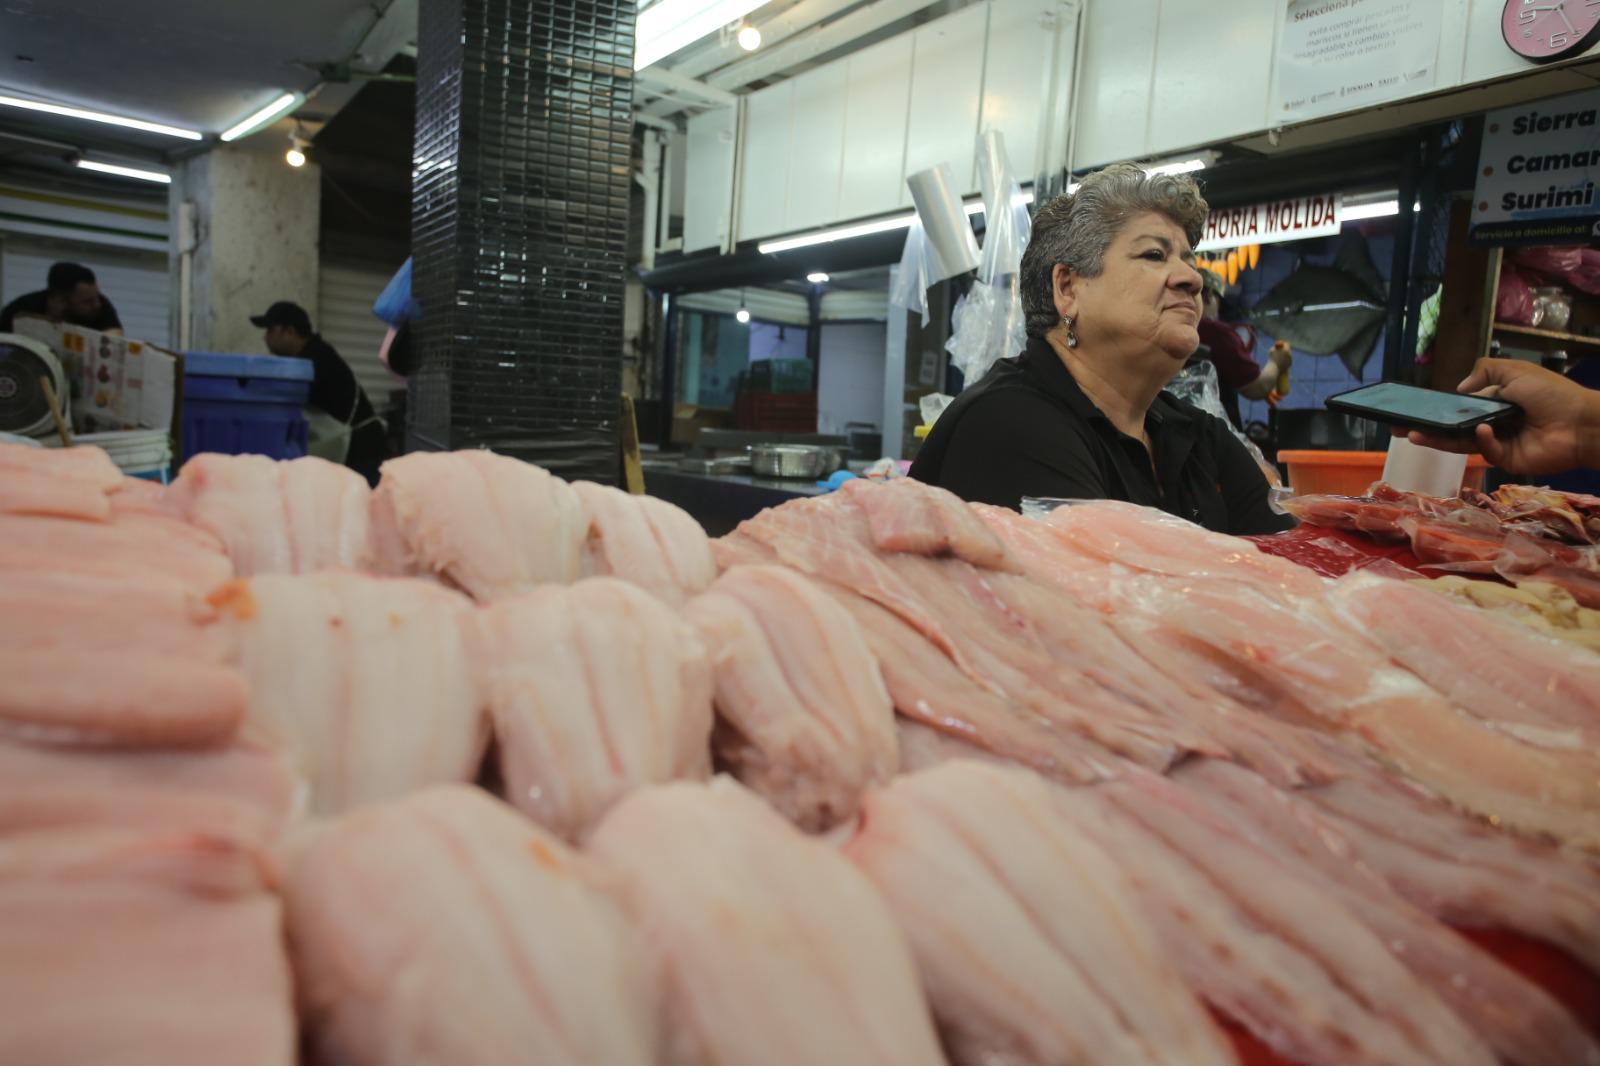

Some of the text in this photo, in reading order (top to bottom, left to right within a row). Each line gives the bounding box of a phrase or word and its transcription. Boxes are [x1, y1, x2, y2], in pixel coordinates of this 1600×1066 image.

[1294, 0, 1348, 22] Selecciona
[1550, 32, 1568, 48] 6
[1512, 110, 1597, 136] Sierra
[1501, 182, 1594, 211] Surimi
[1201, 195, 1335, 240] HORIA MOLIDA
[1523, 225, 1573, 237] domicilio
